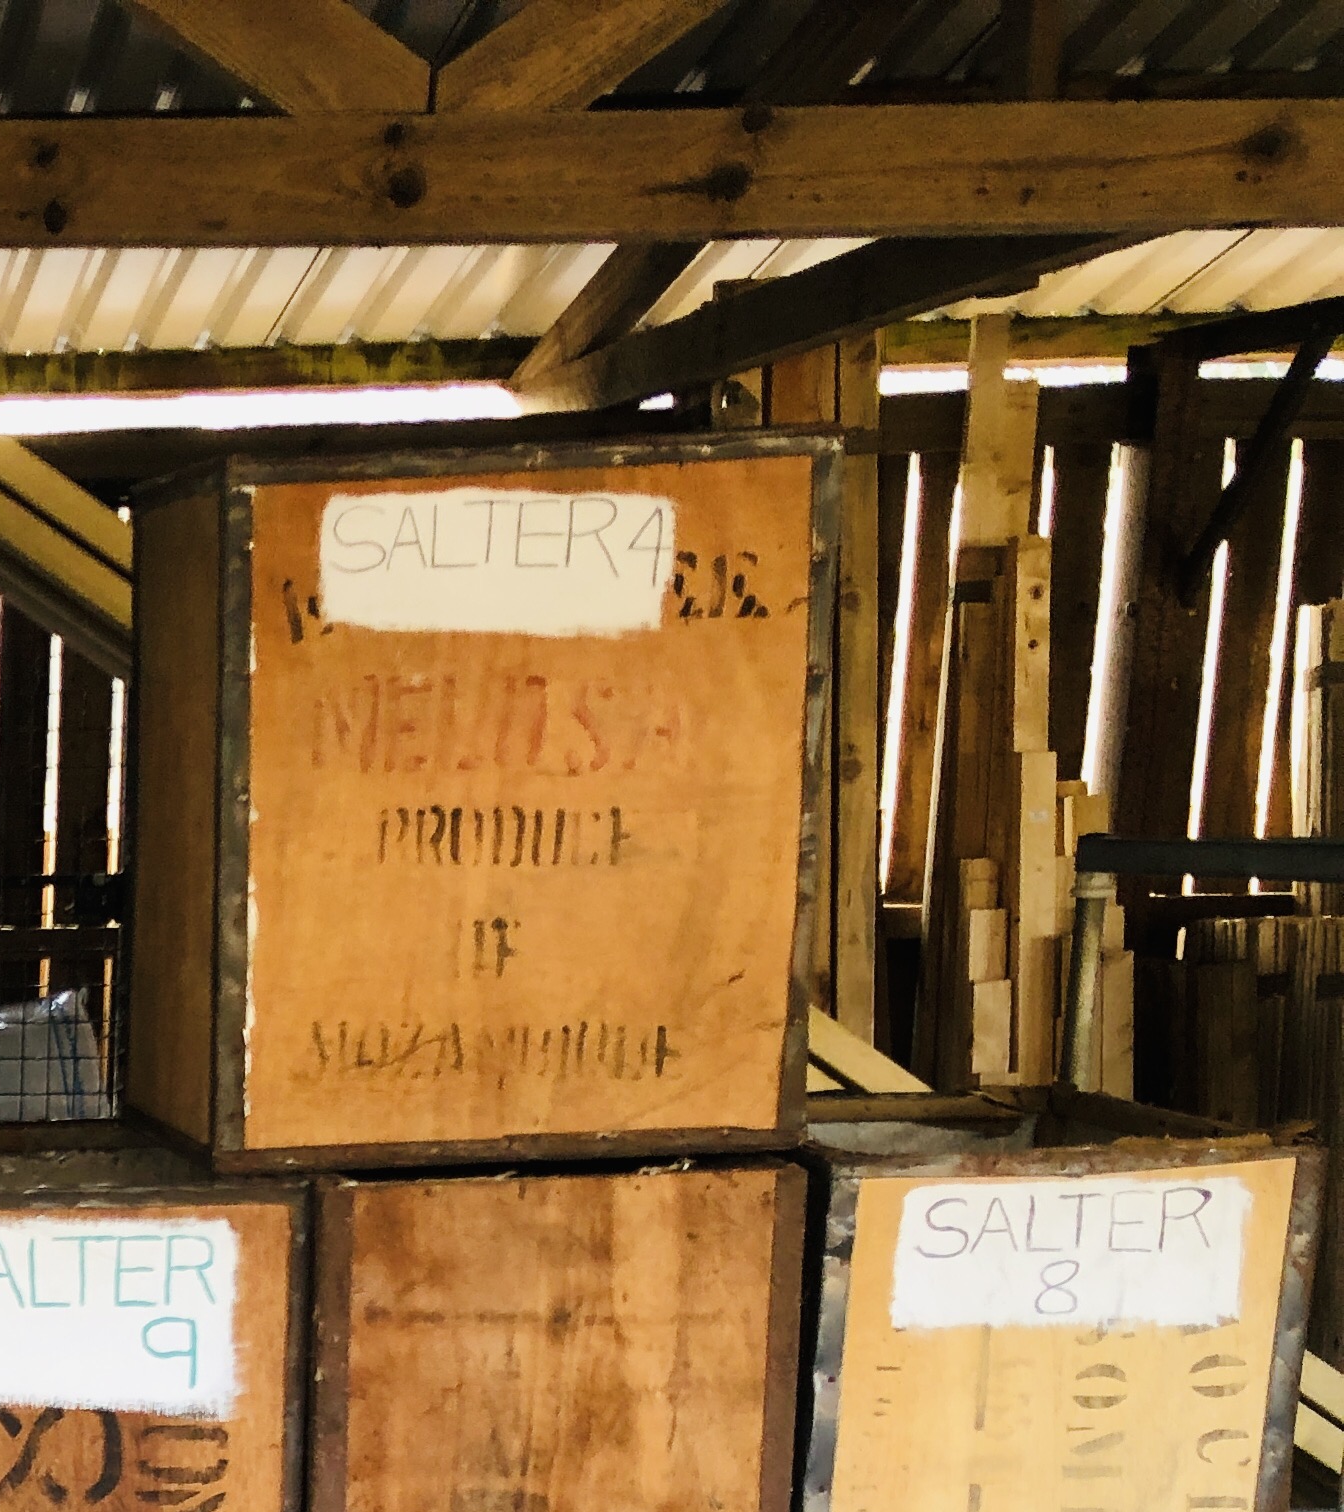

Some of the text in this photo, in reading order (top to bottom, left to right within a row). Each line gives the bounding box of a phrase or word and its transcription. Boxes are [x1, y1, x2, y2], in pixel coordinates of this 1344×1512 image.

[333, 498, 666, 588] SALTER 4
[914, 1184, 1213, 1260] SALTER
[1032, 1258, 1082, 1316] 8
[141, 1314, 200, 1390] 9
